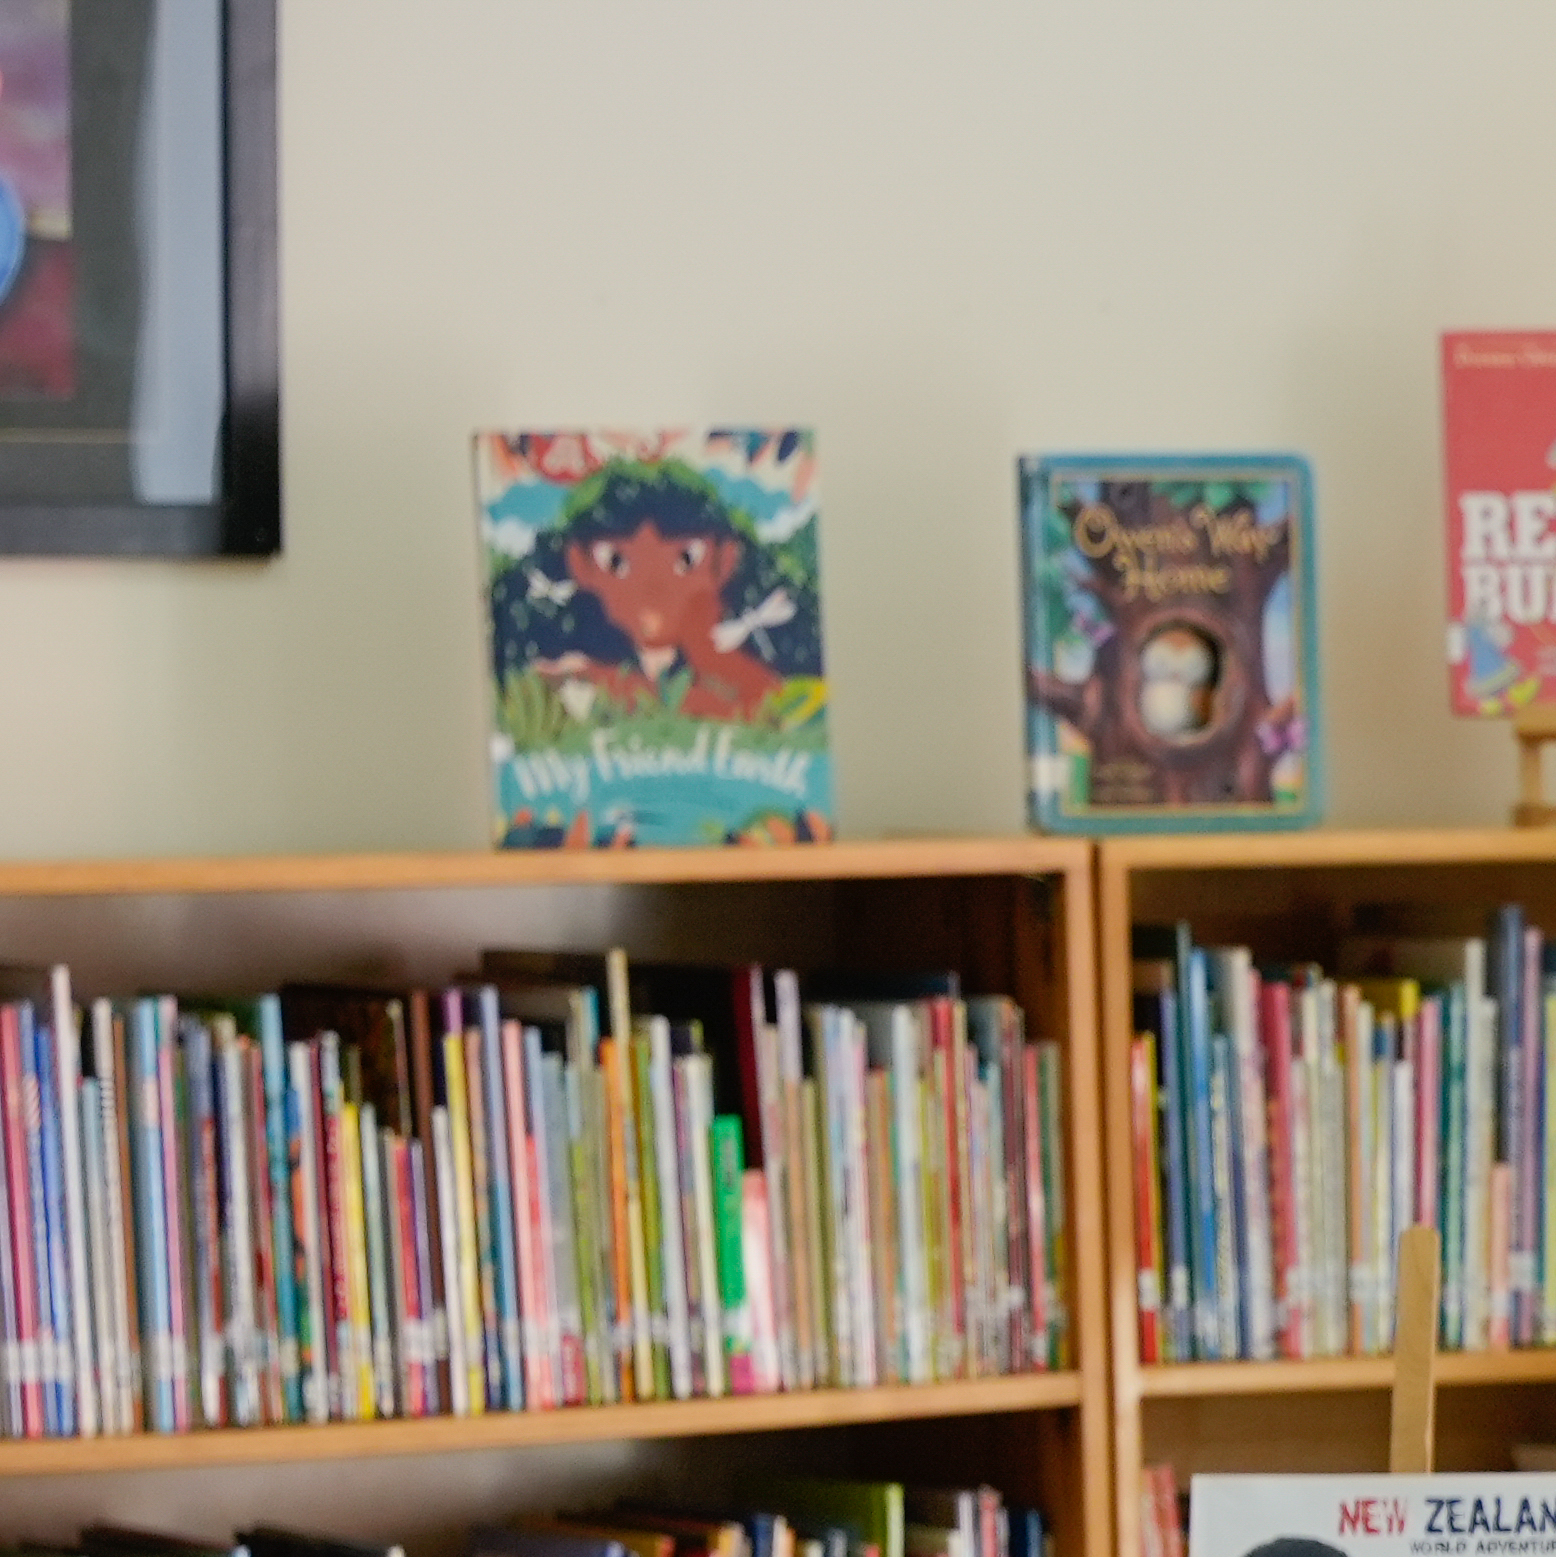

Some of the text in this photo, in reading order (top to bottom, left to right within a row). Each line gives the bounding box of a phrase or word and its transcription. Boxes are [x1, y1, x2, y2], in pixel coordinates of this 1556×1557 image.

[512, 750, 592, 806] My
[590, 725, 708, 782] Friend
[1339, 1496, 1406, 1536] NEW
[1410, 1539, 1466, 1555] WORLD
